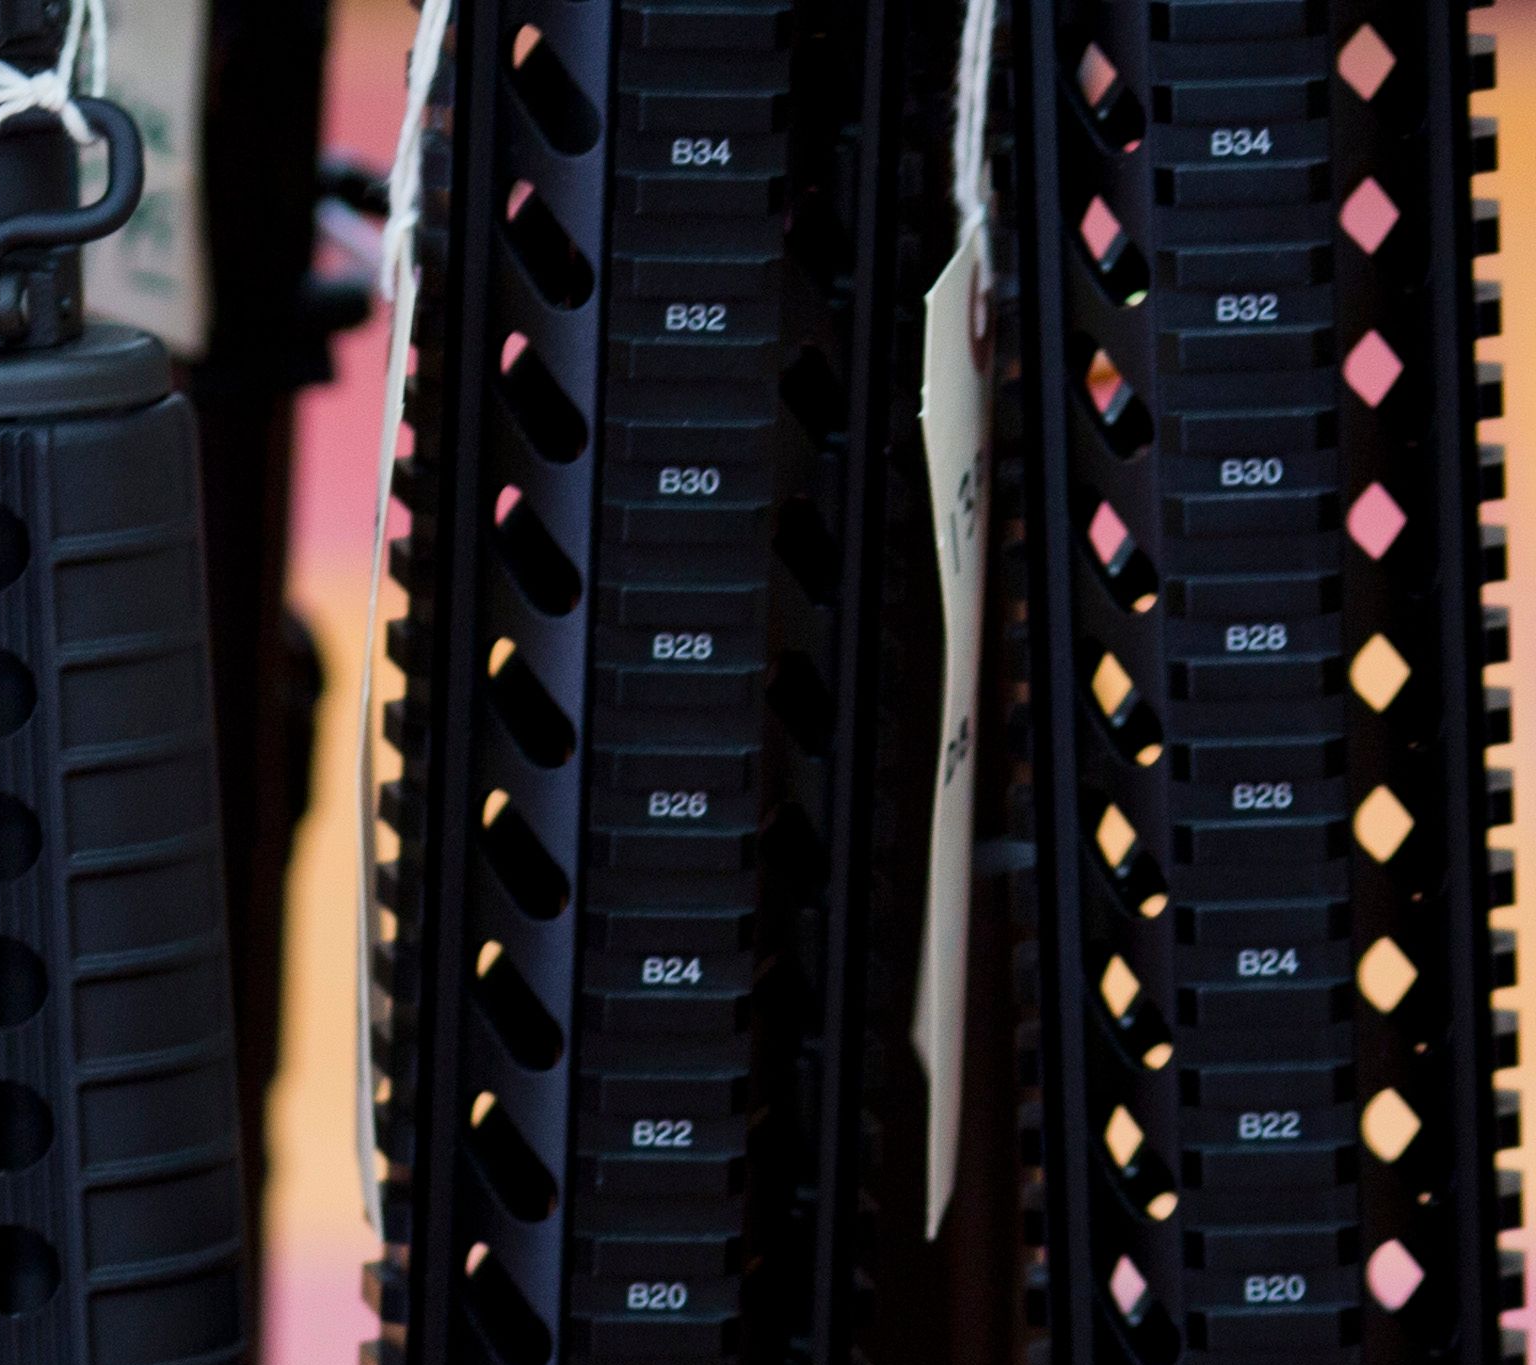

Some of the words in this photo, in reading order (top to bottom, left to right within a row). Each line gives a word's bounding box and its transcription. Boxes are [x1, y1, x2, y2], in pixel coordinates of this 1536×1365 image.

[670, 138, 732, 167] B34
[1209, 127, 1273, 157] B34
[664, 304, 727, 332] B32
[1215, 293, 1279, 323] B32
[657, 467, 721, 496] B30
[1220, 457, 1284, 487] B30
[652, 633, 714, 661] B28
[1225, 623, 1288, 653] B28
[647, 791, 709, 819] B26
[1231, 782, 1294, 811] B26
[641, 956, 703, 985] B24
[1237, 948, 1300, 977] B24
[631, 1119, 693, 1148] B22
[1238, 1111, 1301, 1140] B22
[626, 1282, 689, 1311] B20
[1244, 1274, 1307, 1303] B20
